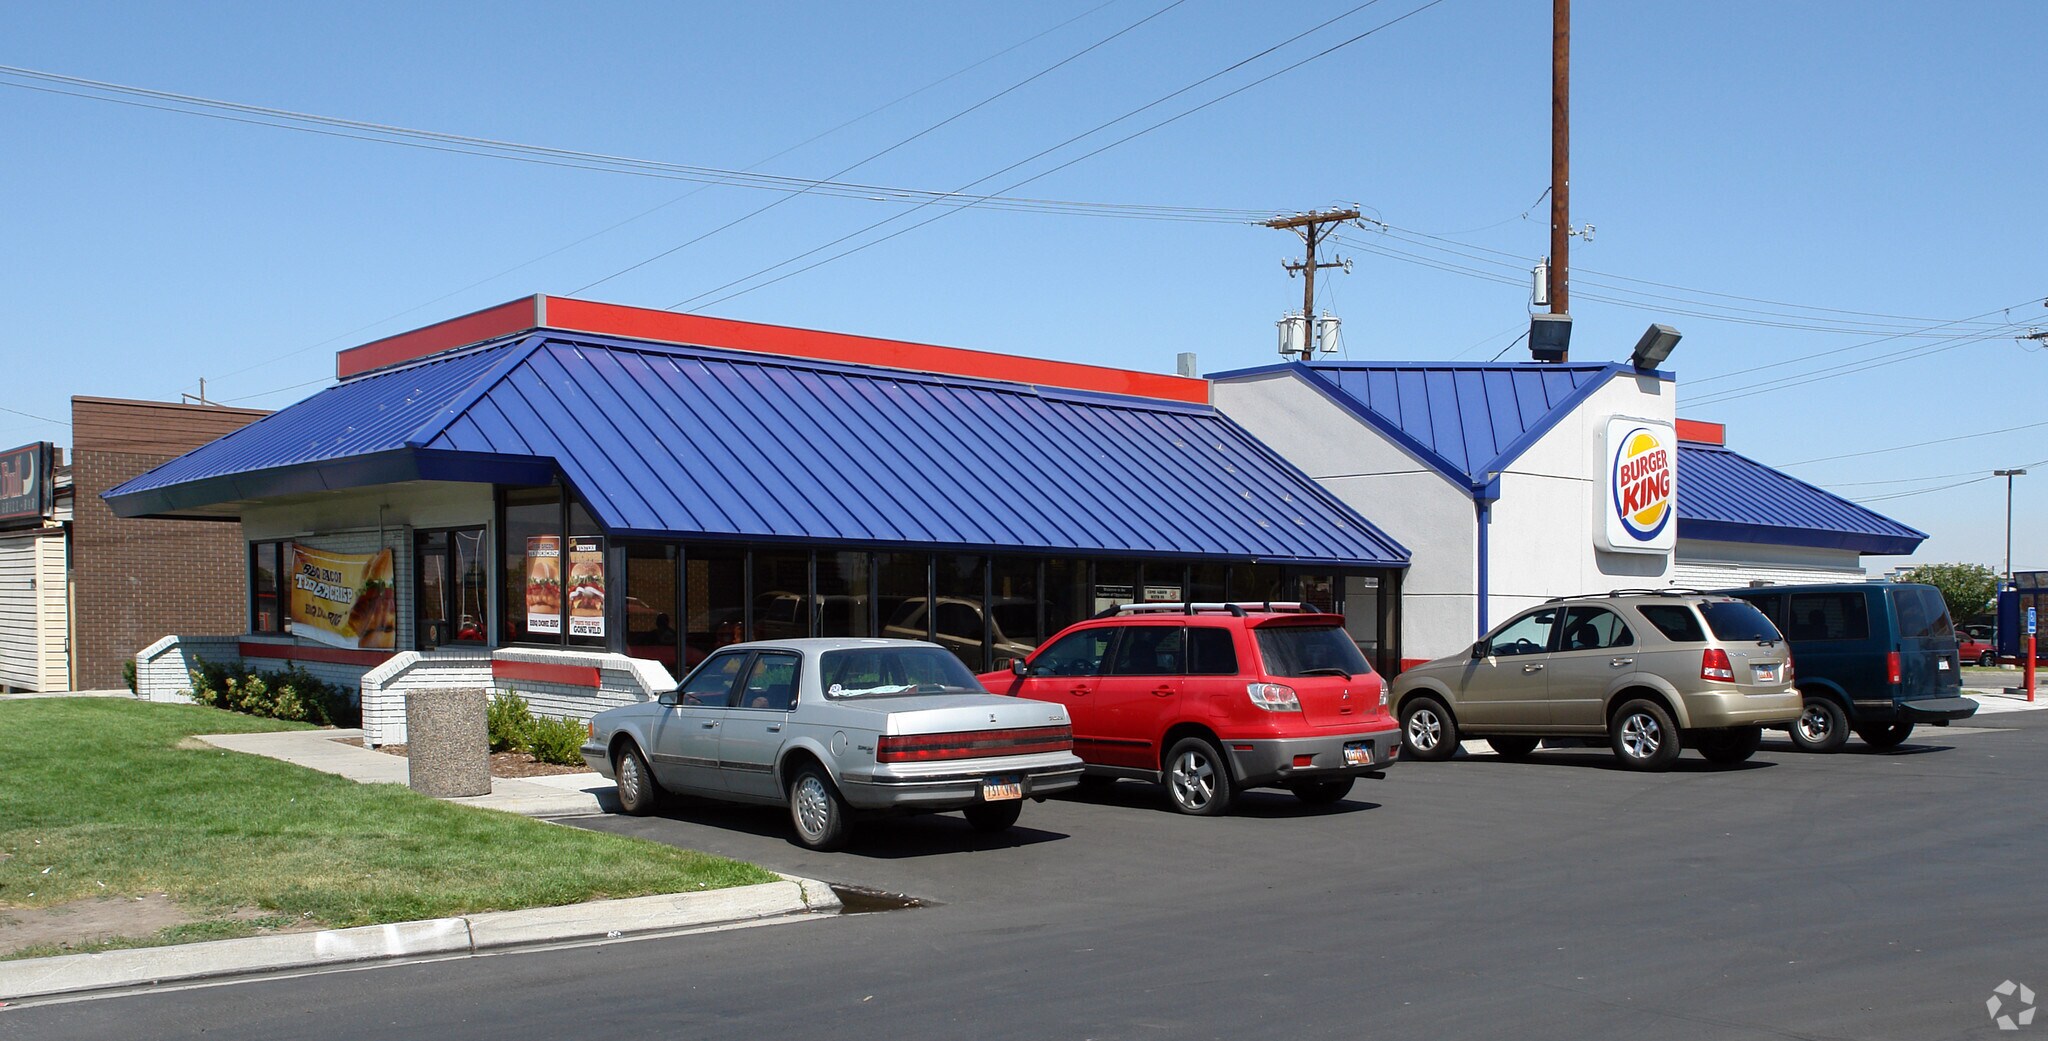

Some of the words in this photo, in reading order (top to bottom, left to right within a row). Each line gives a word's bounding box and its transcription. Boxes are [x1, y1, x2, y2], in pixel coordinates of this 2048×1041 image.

[1621, 449, 1668, 488] BURGER
[1622, 468, 1670, 518] KING
[573, 626, 587, 634] GONE
[588, 626, 602, 635] WILD
